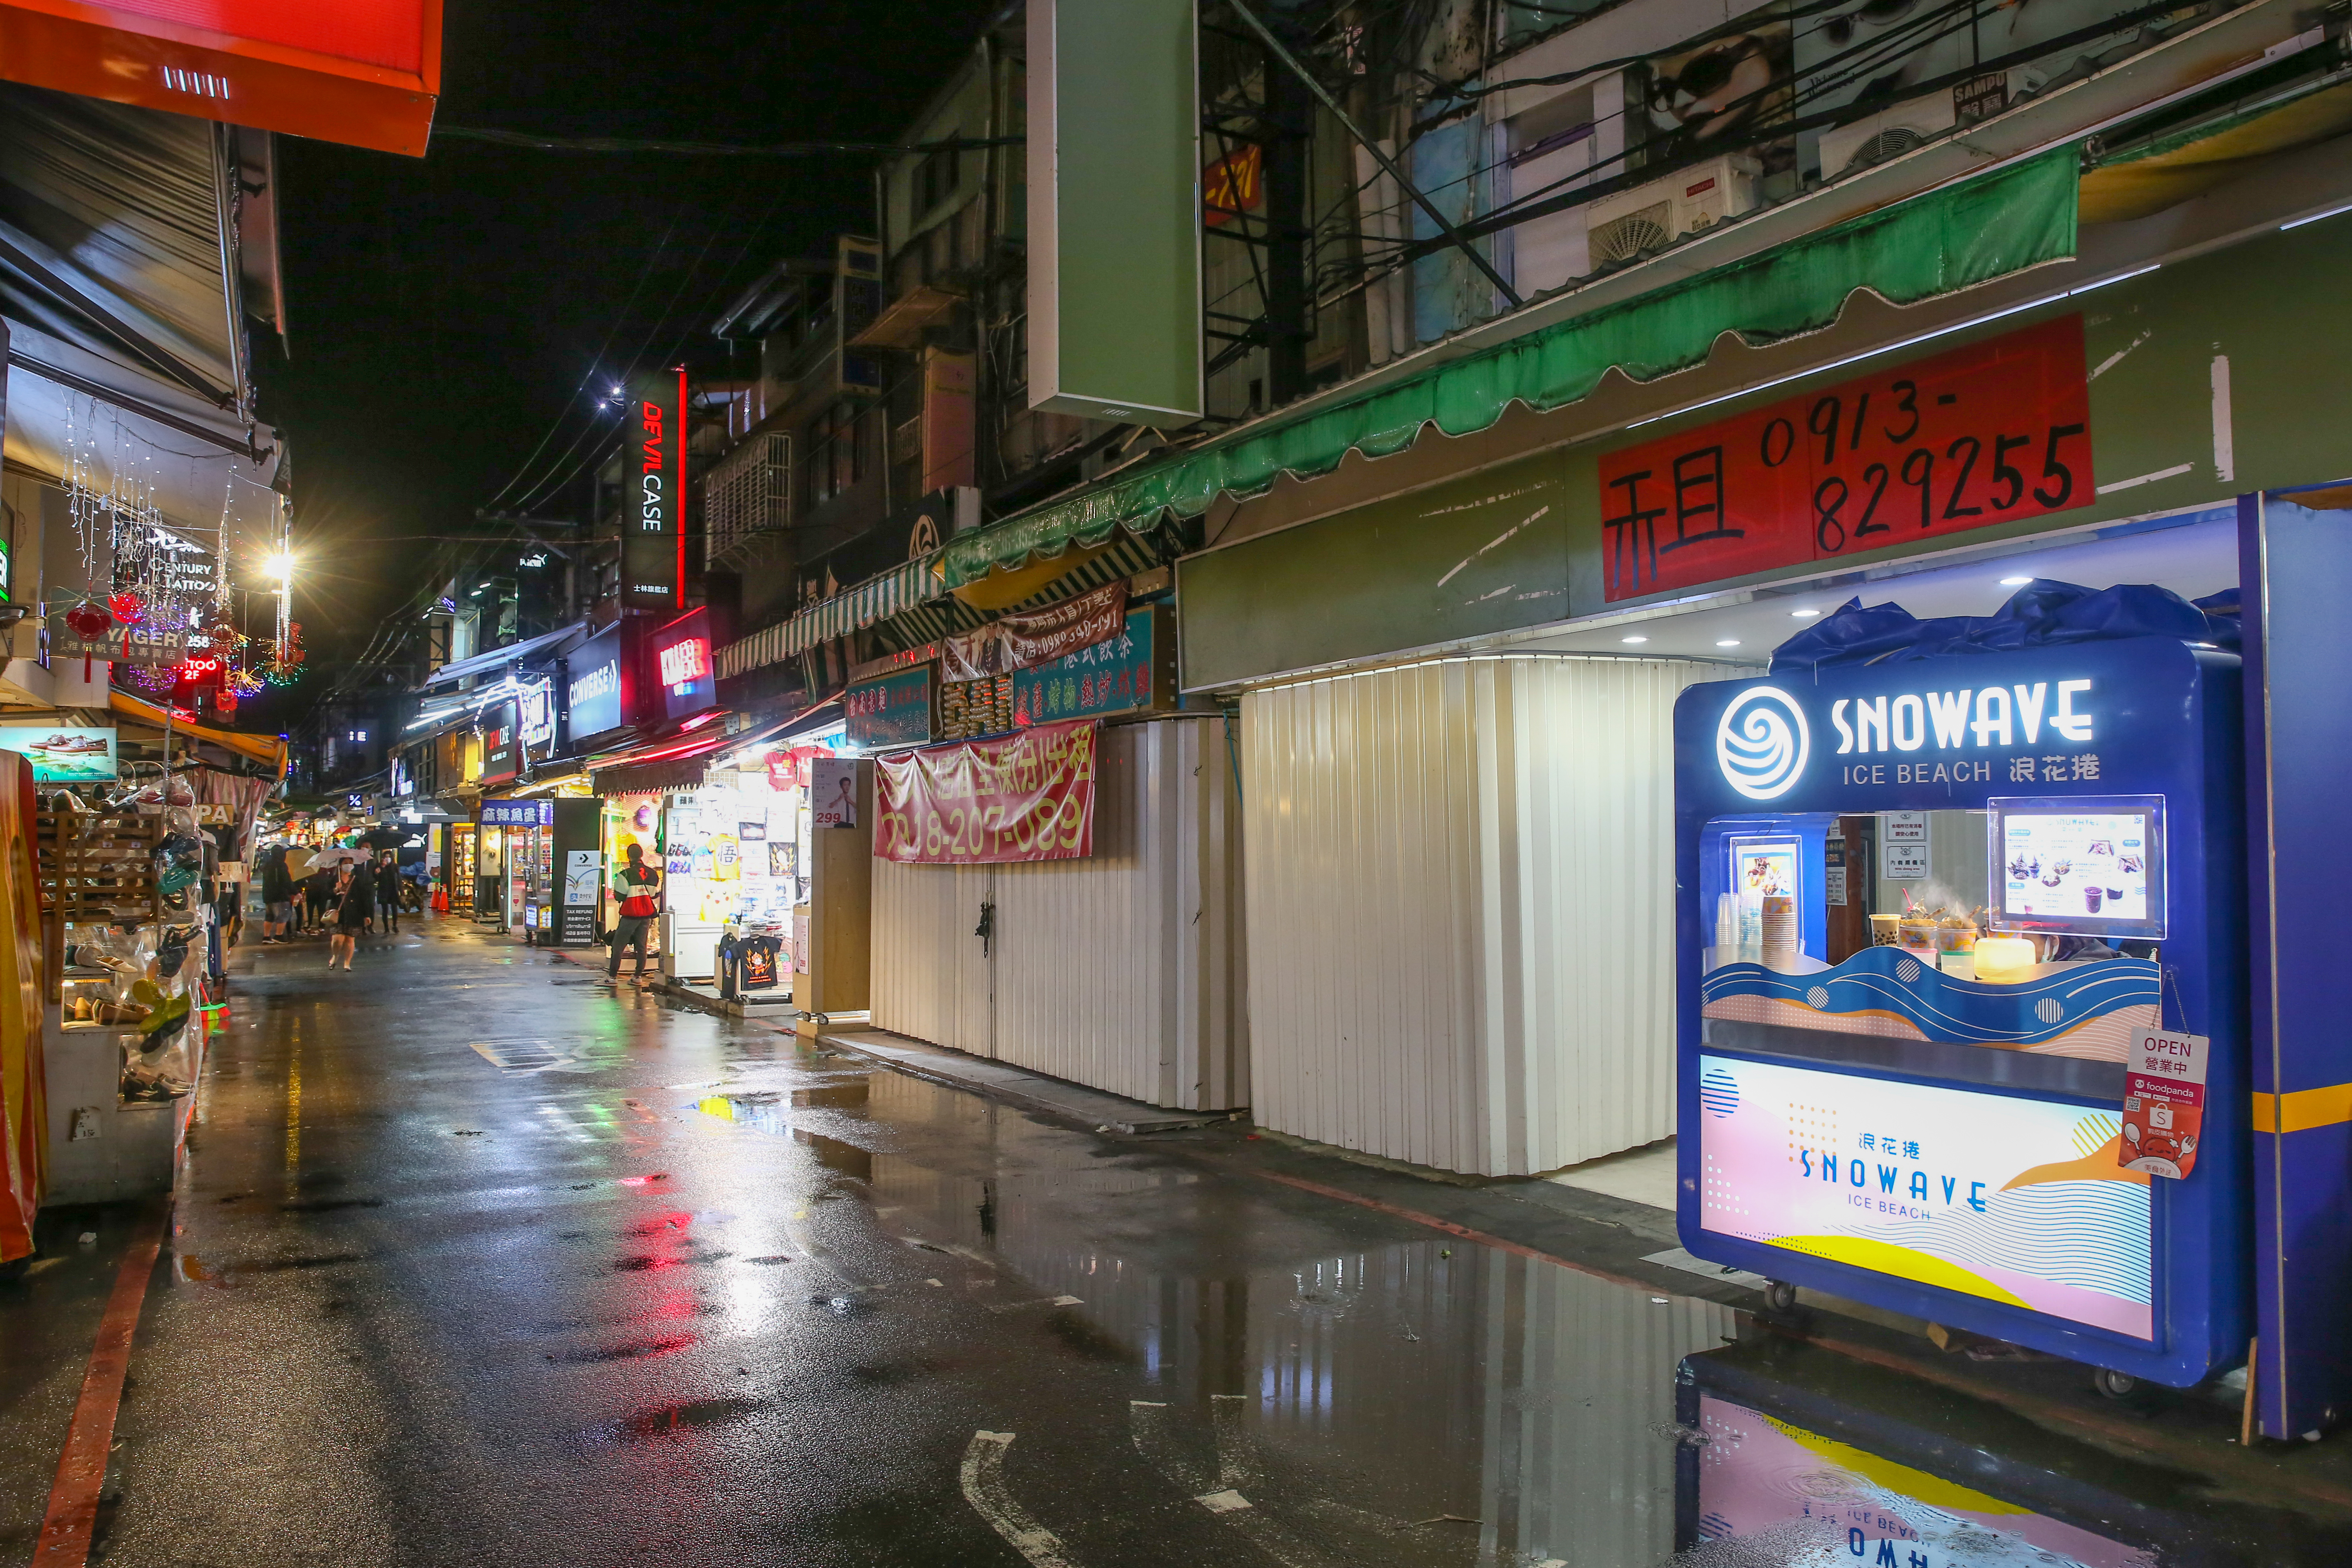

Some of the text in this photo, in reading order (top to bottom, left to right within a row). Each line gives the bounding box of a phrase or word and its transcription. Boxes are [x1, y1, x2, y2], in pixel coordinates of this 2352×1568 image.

[1955, 72, 2005, 102] SAMPO
[1687, 180, 1714, 195] HITACHI
[1761, 380, 1957, 468] 0913-
[643, 401, 662, 531] DEVILCASE
[1814, 422, 2085, 552] 829255
[1604, 444, 1745, 590] 租
[633, 584, 668, 594] 士林旗艦店
[107, 628, 178, 648] YAGER
[184, 670, 200, 680] 2F
[569, 665, 609, 709] CONVERSE
[1831, 679, 2092, 754] SNOWAVE
[1844, 761, 1991, 785] ICE BEACH
[2009, 753, 2100, 783] 浪花捲
[482, 807, 536, 822] 麻辣魚蛋
[815, 812, 841, 823] 299
[718, 845, 737, 863] 悟
[2144, 1037, 2191, 1057] OPEN
[2145, 1056, 2187, 1075] 營業中
[2146, 1081, 2194, 1098] foodpanda
[2157, 1111, 2166, 1126] S
[2147, 1128, 2174, 1138] 蝦皮購物
[1858, 1131, 1920, 1160] 浪花捲
[2144, 1164, 2172, 1176] 美食外送
[1801, 1150, 1986, 1213] SNOWAVE
[1848, 1193, 1931, 1221] ICE BEACH
